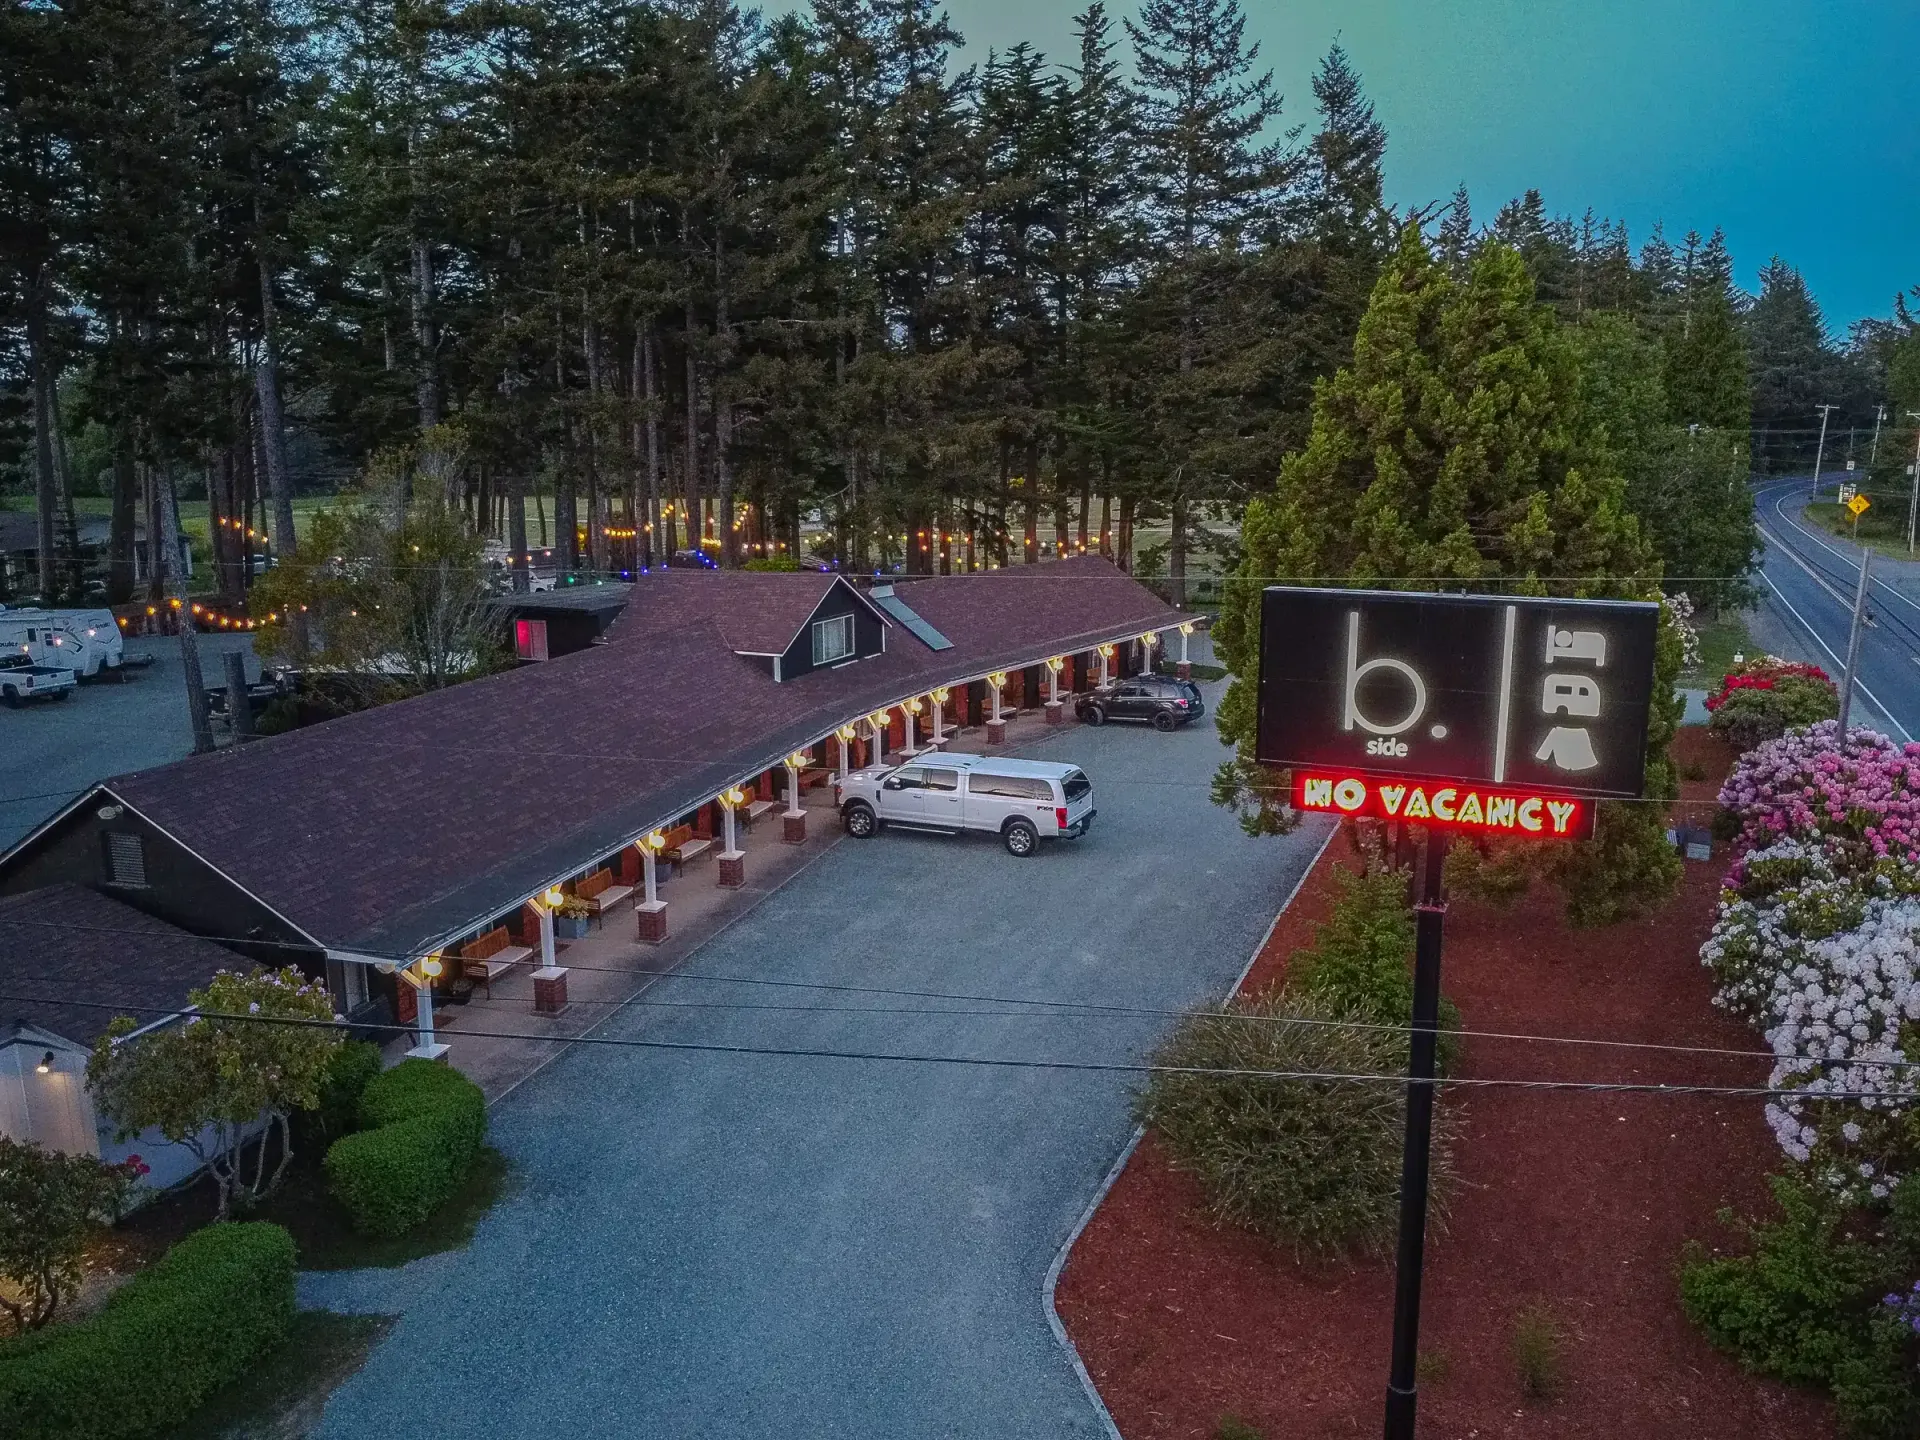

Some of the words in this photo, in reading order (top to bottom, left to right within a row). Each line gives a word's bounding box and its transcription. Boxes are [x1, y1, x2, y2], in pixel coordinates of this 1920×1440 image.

[1366, 737, 1409, 757] side
[1304, 778, 1367, 811] NO
[1379, 784, 1576, 833] VACANCY
